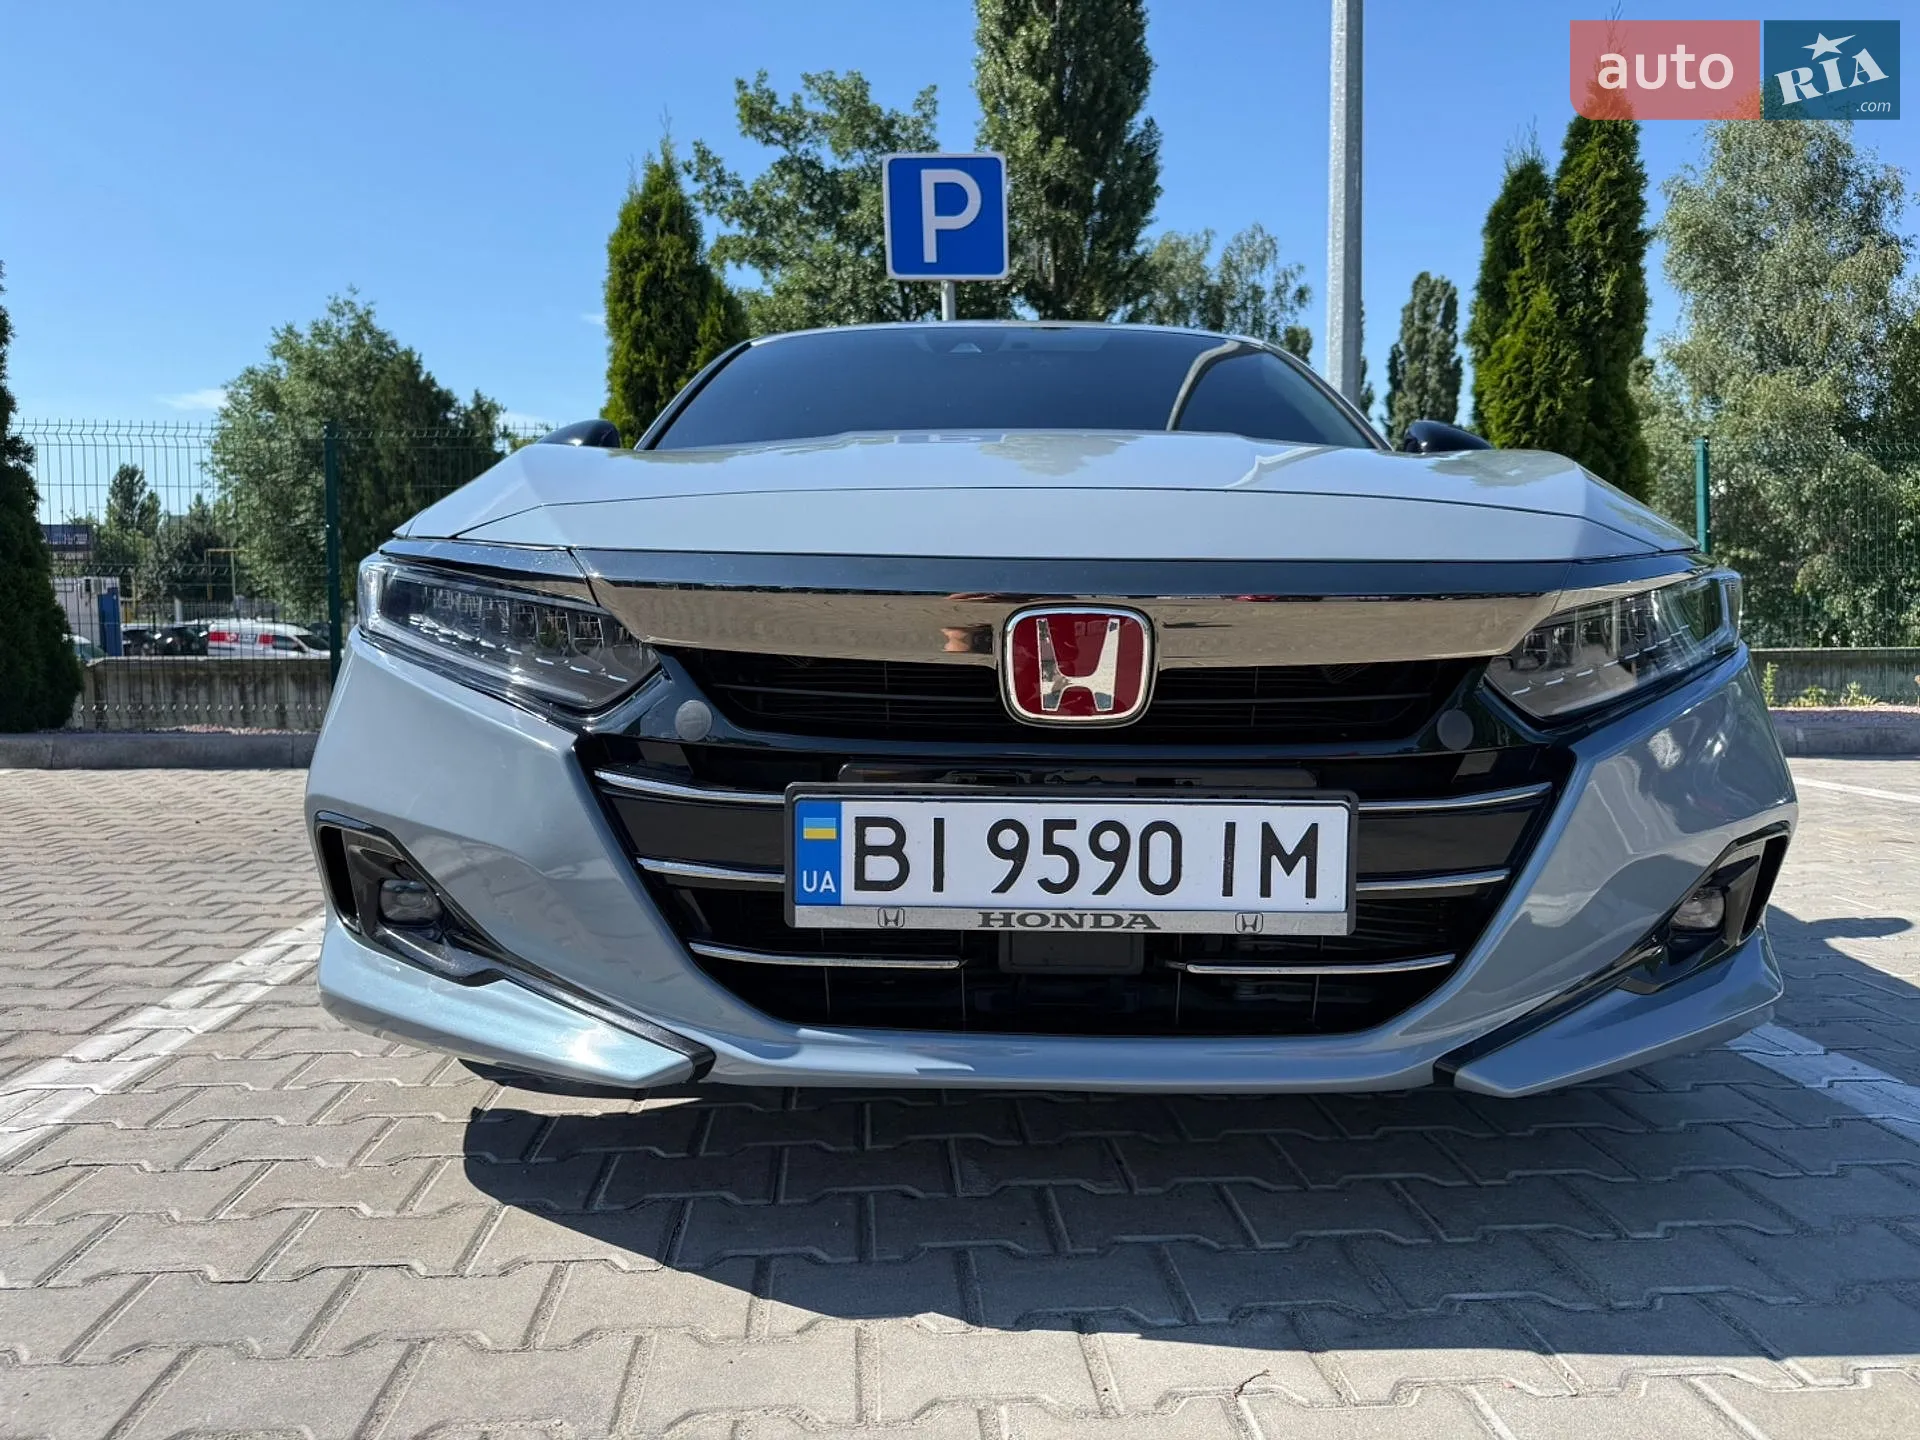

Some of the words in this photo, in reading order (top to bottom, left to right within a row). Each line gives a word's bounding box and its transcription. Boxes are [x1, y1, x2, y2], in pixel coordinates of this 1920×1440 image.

[920, 168, 982, 264] P
[802, 870, 837, 894] UA
[853, 816, 945, 893] BI
[986, 817, 1184, 897] 9590
[1221, 821, 1320, 899] IM
[977, 911, 1162, 931] HONDA
